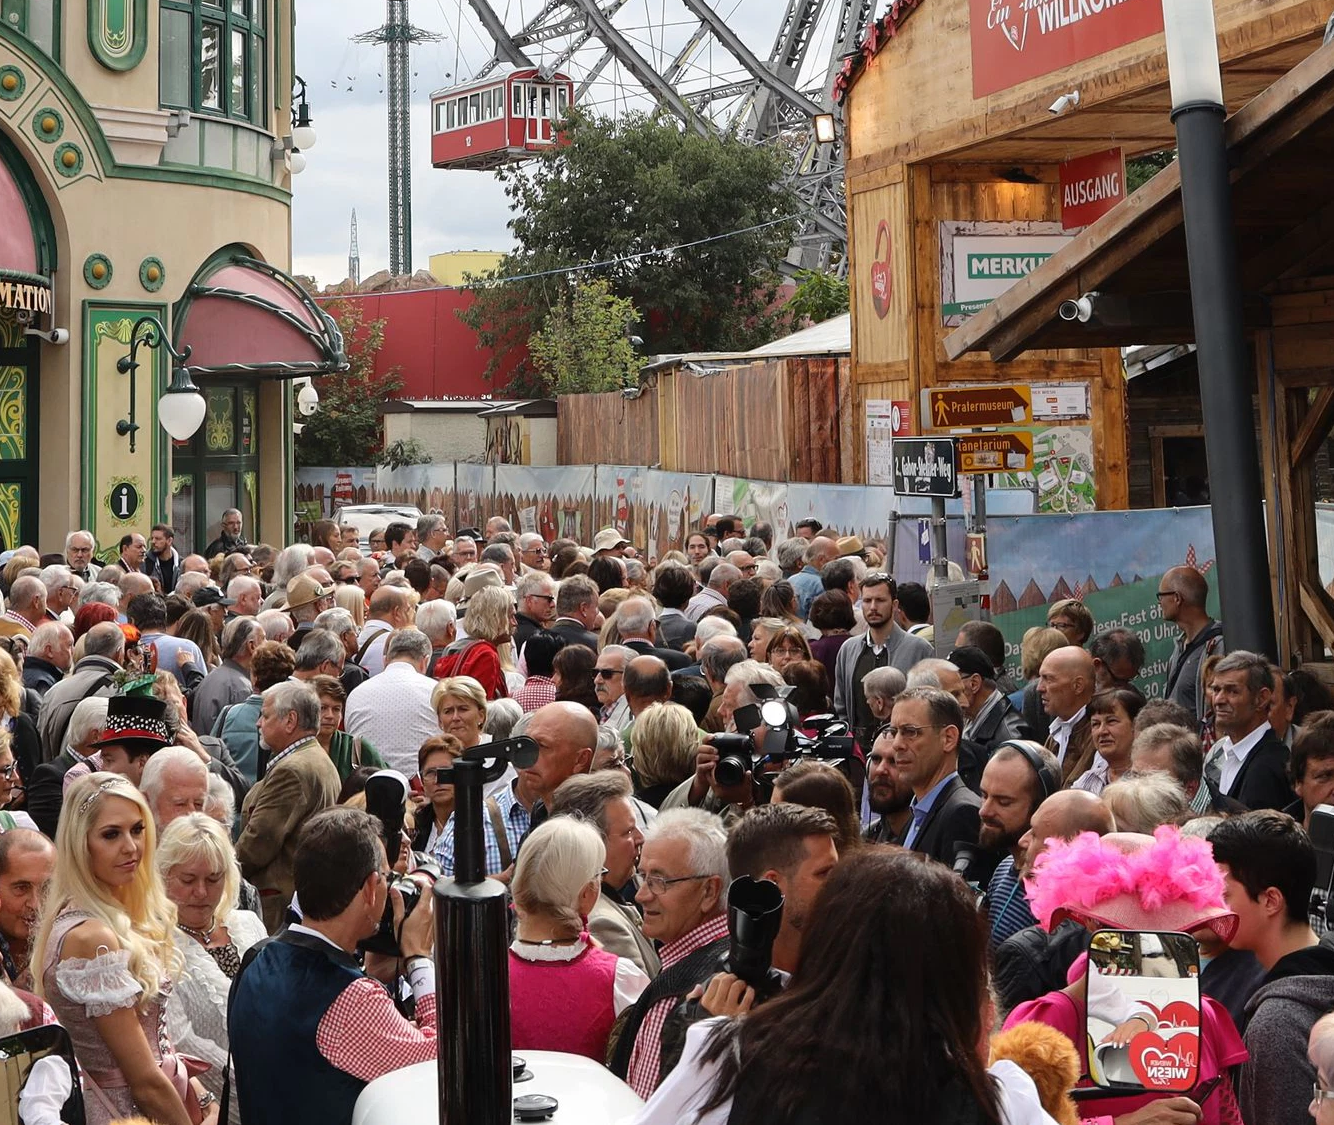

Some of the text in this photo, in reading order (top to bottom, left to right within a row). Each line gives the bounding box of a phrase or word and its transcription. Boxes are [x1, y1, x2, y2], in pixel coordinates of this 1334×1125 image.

[1064, 173, 1120, 208] AUSGANG
[971, 255, 1053, 275] MERKU
[960, 300, 993, 312] Present
[951, 400, 1015, 413] Pratermuseum
[956, 440, 1011, 453] lanetarium
[1093, 612, 1148, 635] iesn-Fest
[1154, 622, 1180, 641] Uhr!
[1140, 660, 1169, 678] estiv
